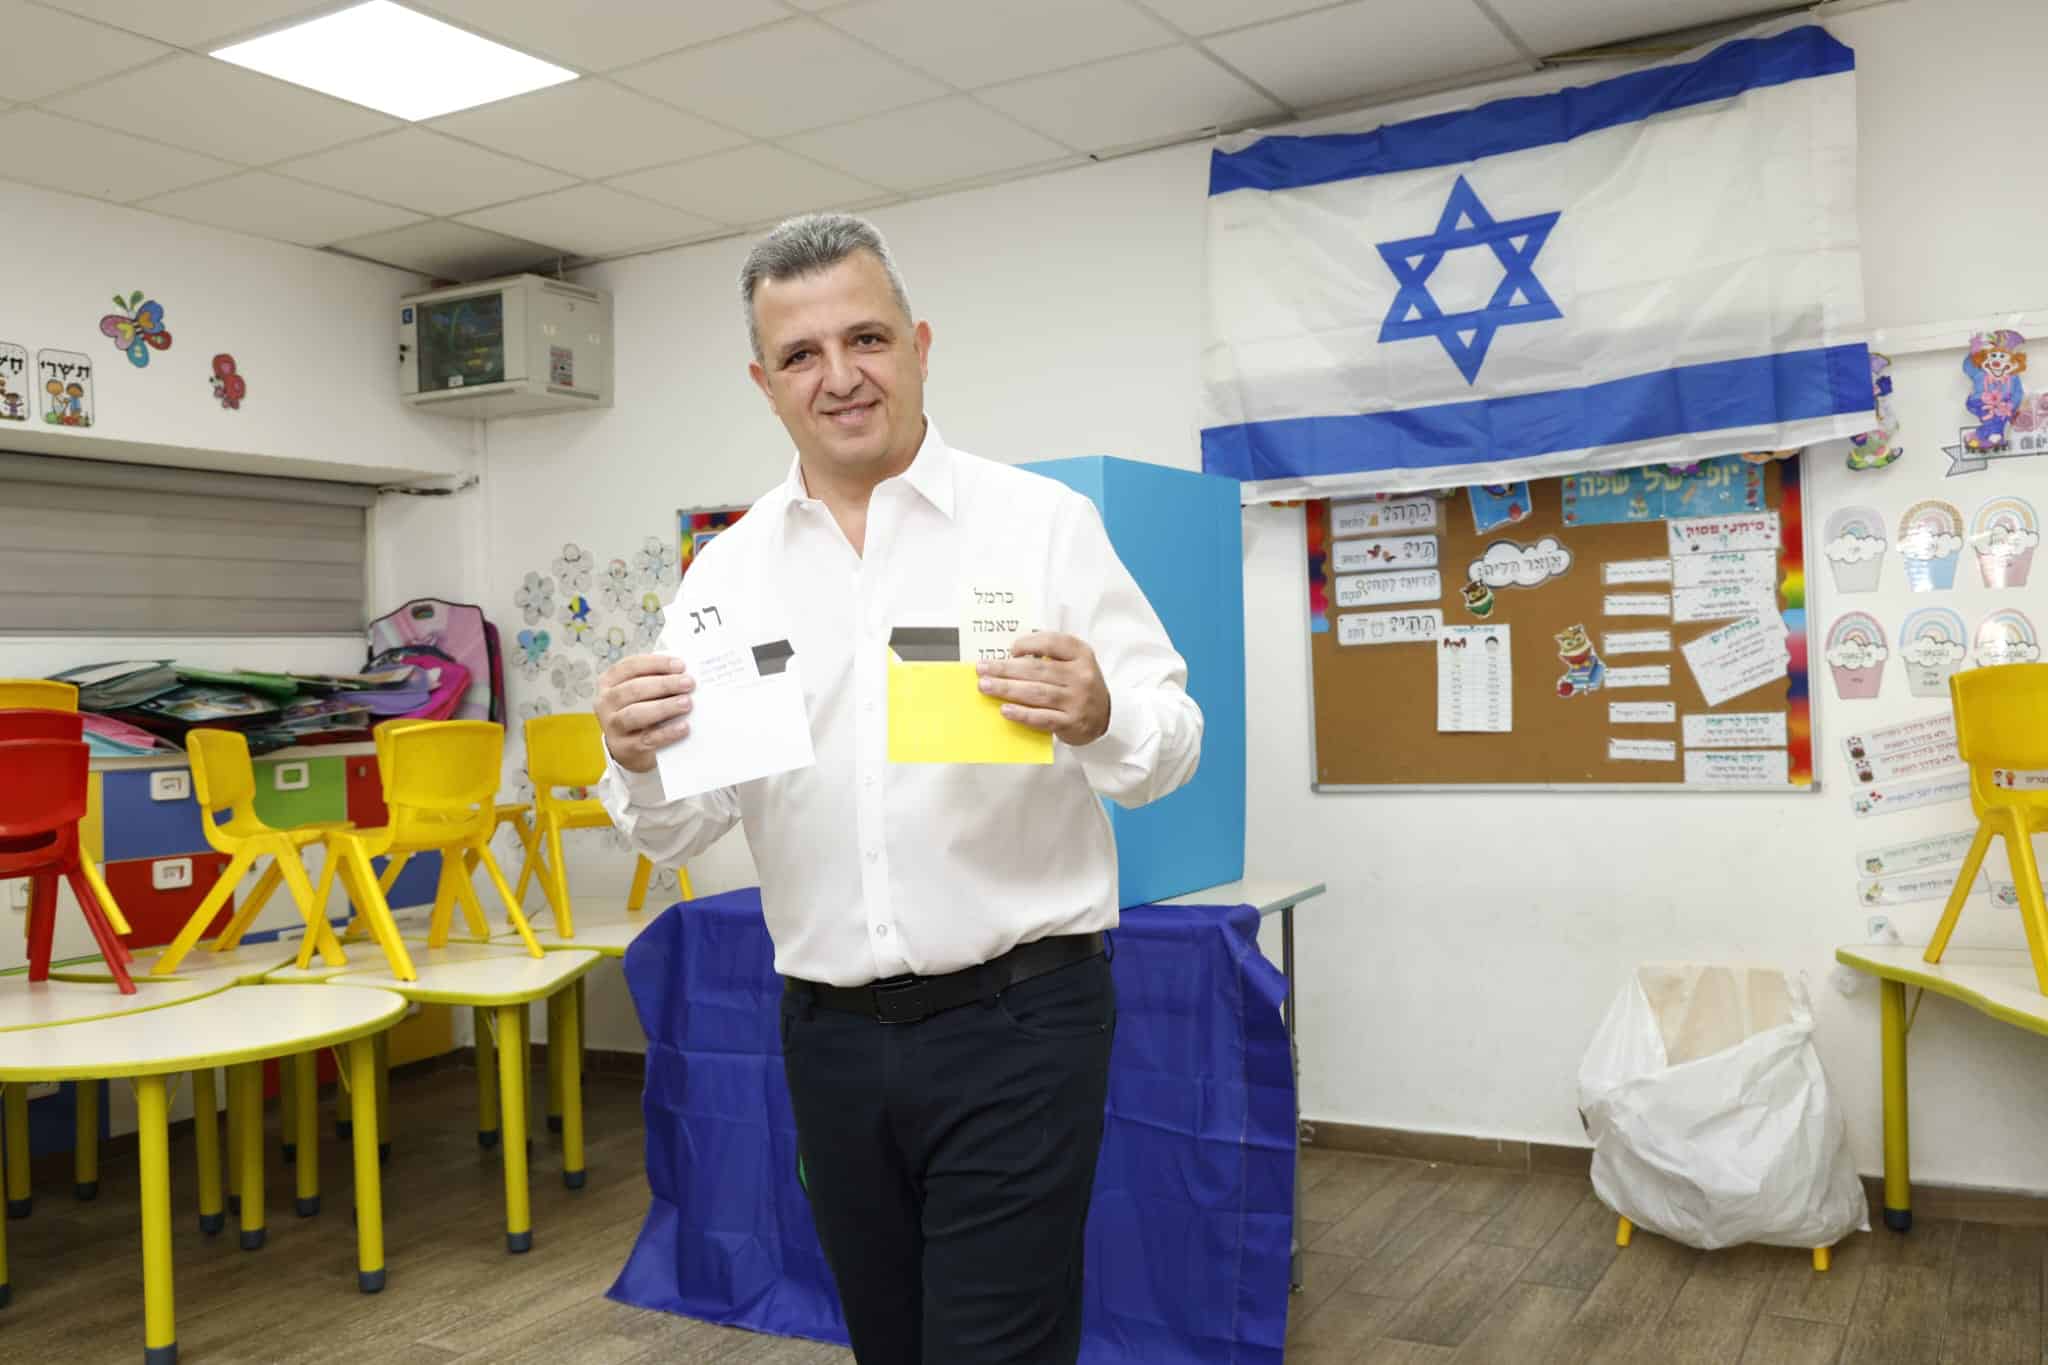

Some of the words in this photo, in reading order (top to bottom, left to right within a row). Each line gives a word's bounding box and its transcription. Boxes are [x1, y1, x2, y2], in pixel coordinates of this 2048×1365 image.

[973, 586, 1014, 605] כרמל
[689, 605, 722, 634] רג
[972, 619, 1020, 632] שאמה
